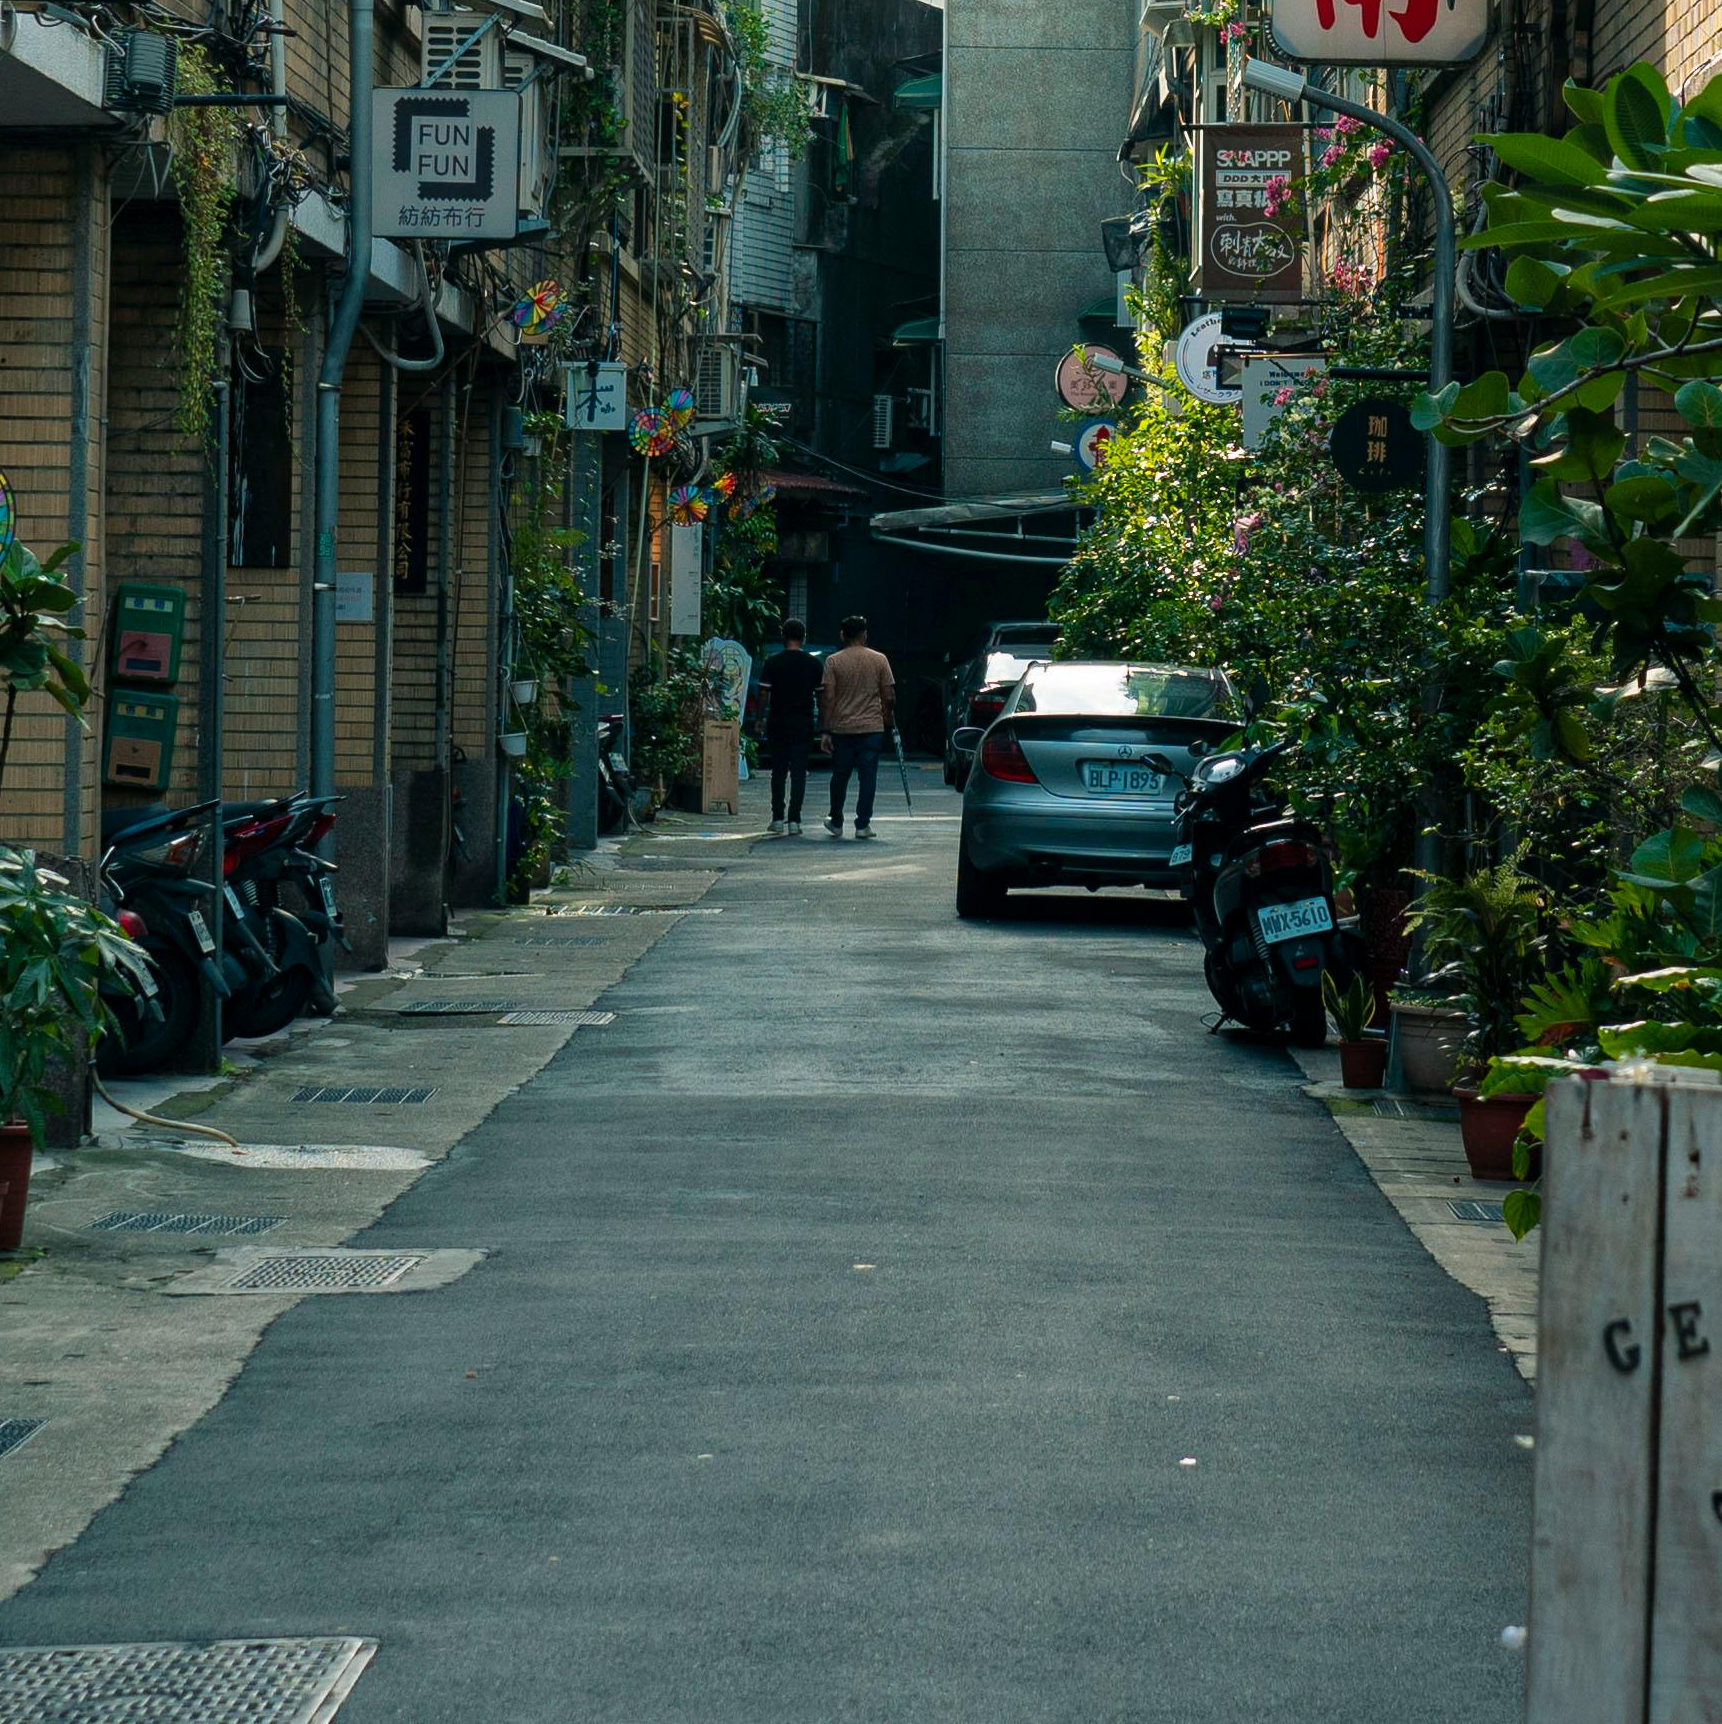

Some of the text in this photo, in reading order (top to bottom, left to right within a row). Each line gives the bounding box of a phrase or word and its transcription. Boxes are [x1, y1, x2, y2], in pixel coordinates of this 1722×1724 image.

[419, 123, 470, 146] FUN
[418, 154, 469, 176] FUN
[1223, 175, 1248, 183] DDD
[398, 204, 486, 228] 紡紡布行
[1190, 318, 1223, 338] Leathe
[1366, 414, 1389, 464] 珈琲
